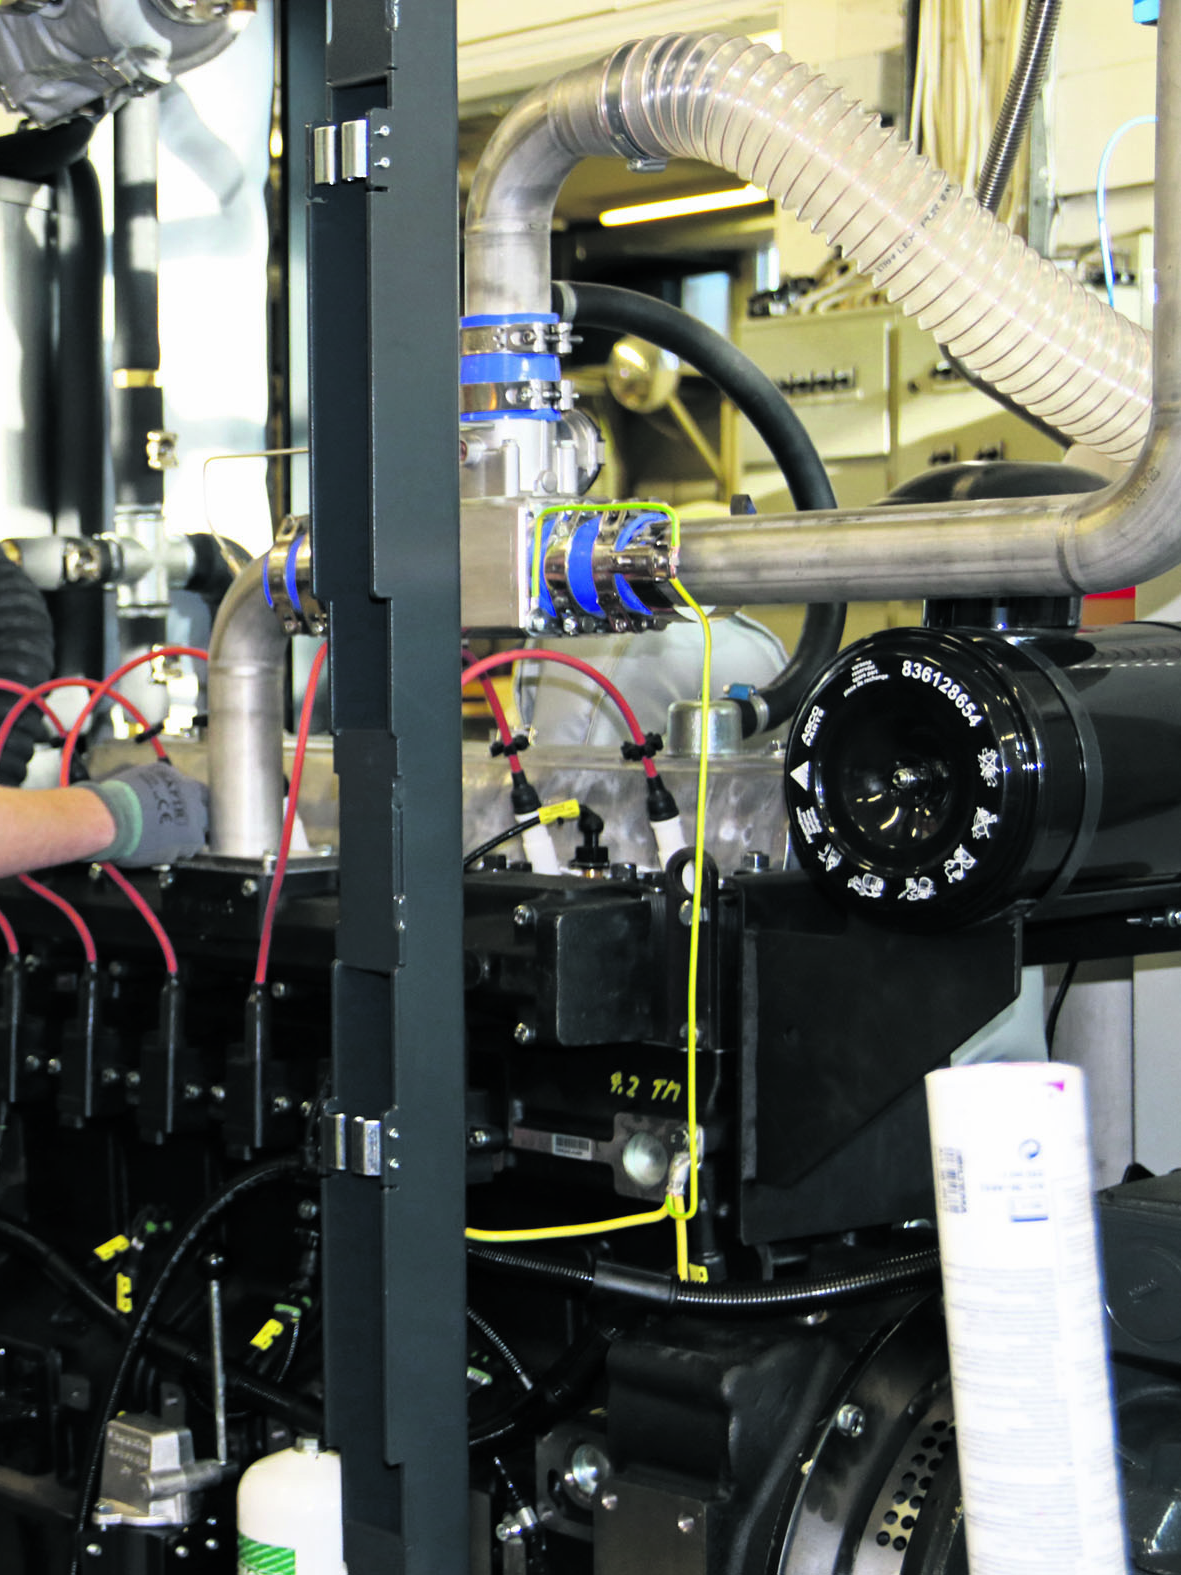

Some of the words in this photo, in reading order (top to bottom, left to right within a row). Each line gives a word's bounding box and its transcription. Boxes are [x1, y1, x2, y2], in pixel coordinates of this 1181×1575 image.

[901, 659, 983, 728] 836128654
[801, 704, 820, 744] AGCO
[805, 709, 825, 747] PARTS
